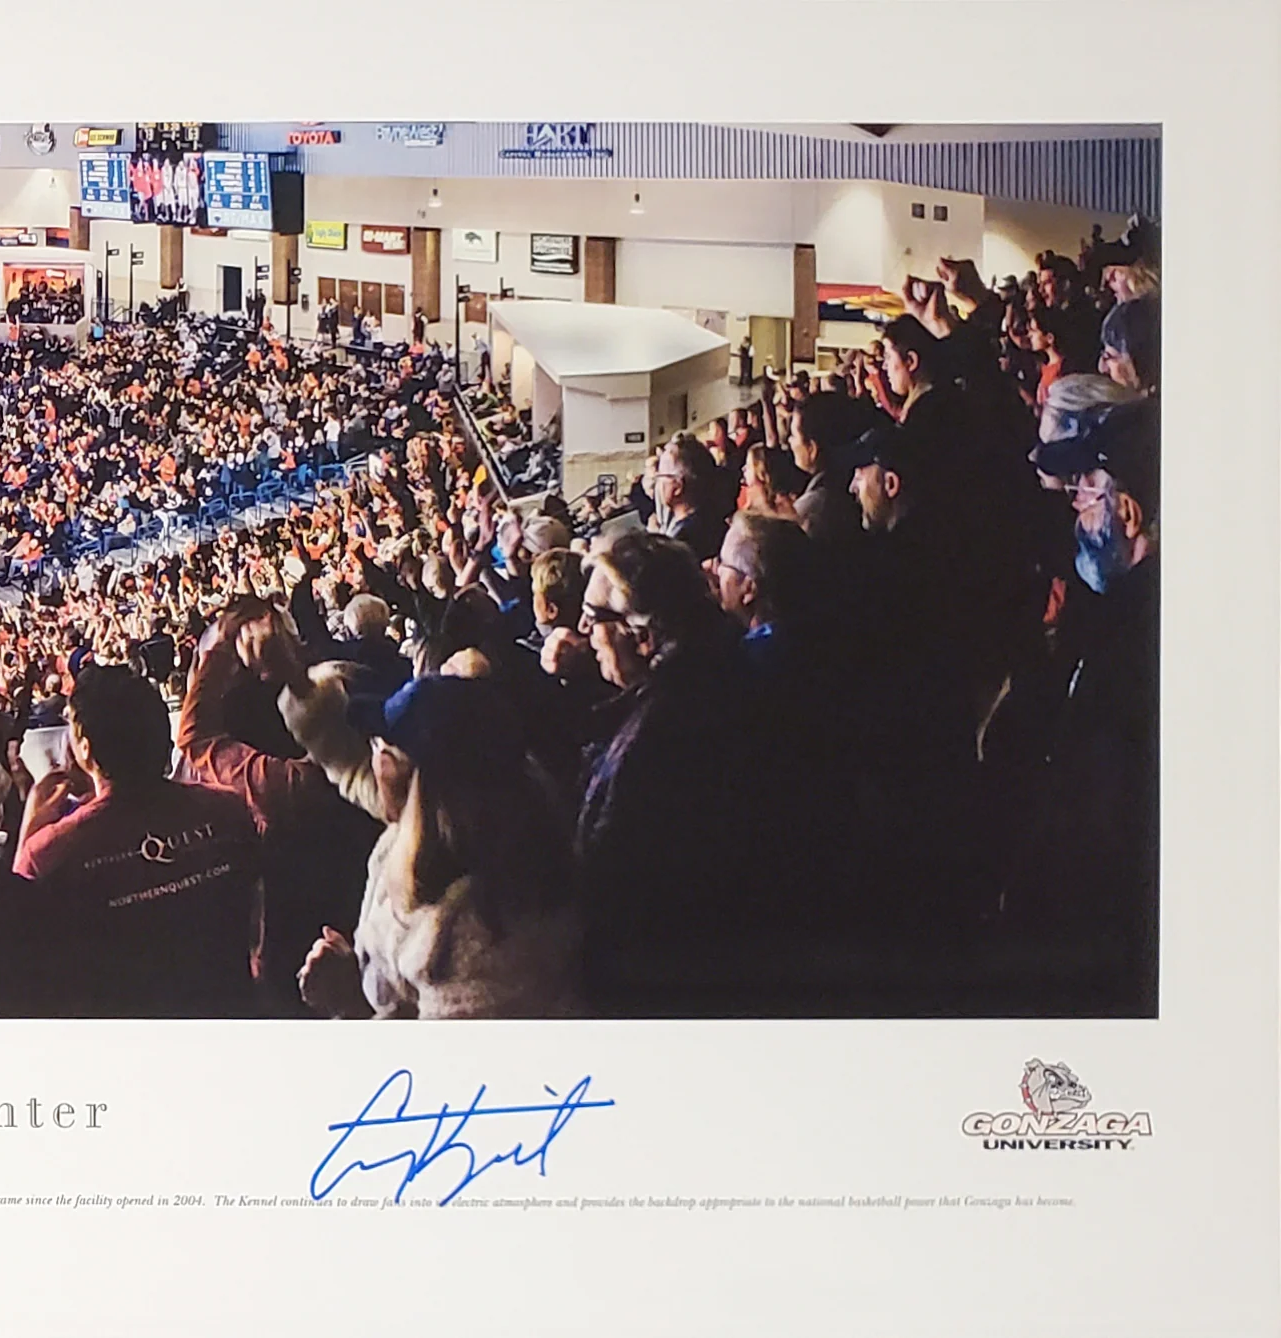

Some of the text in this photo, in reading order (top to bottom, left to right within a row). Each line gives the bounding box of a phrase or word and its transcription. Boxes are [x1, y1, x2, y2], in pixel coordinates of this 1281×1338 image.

[287, 130, 334, 145] TOYOTA
[527, 123, 589, 146] HART
[962, 1112, 1153, 1137] GONZAGA
[983, 1138, 1133, 1150] UNIVERSITY
[26, 1193, 52, 1206] since
[56, 1193, 72, 1206] the
[74, 1193, 113, 1210] facility
[116, 1193, 154, 1210] opened
[157, 1193, 169, 1206] in
[173, 1193, 206, 1206] 2004.
[213, 1193, 235, 1206] The
[239, 1193, 277, 1206] Kennel
[351, 1194, 378, 1207] draw
[410, 1194, 433, 1207] into
